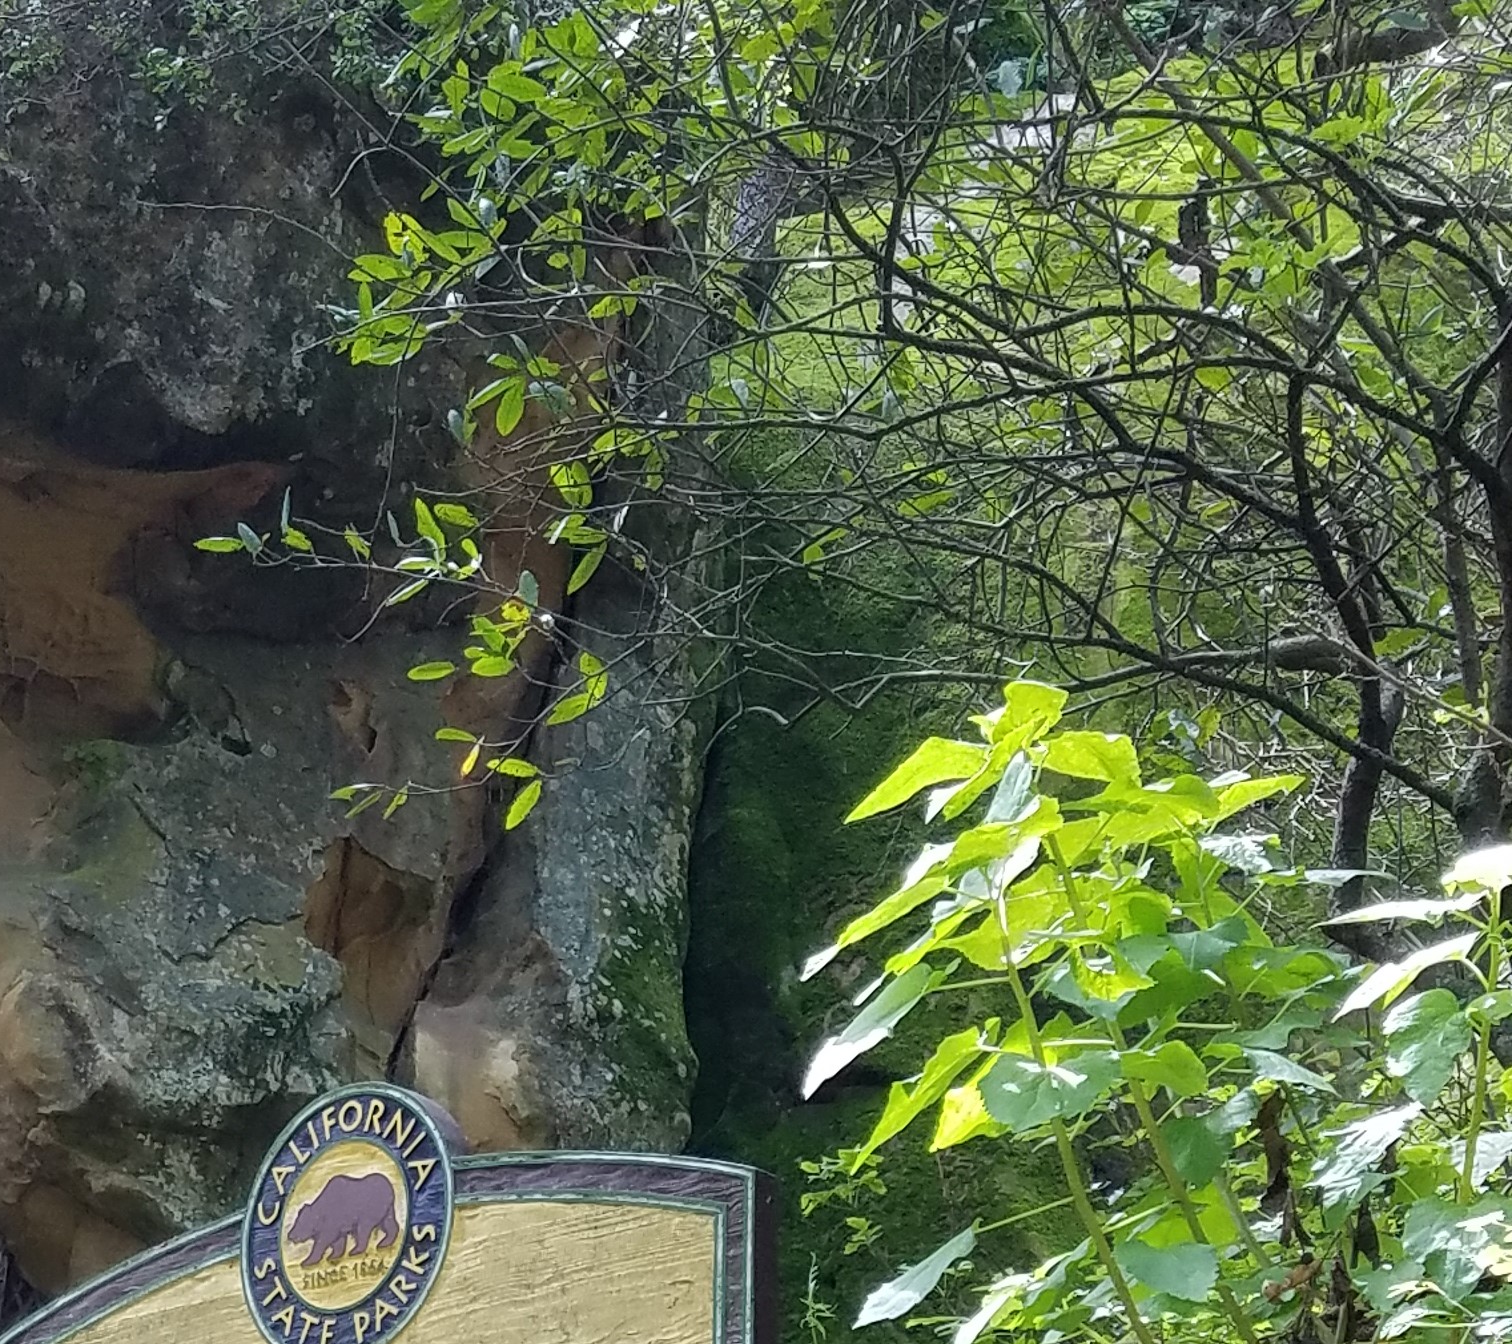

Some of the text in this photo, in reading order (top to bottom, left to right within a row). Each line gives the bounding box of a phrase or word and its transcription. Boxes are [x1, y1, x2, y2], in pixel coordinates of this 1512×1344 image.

[258, 1099, 438, 1225] CALIFORNIA
[301, 1265, 349, 1290] SINCE
[353, 1224, 436, 1344] PARKS
